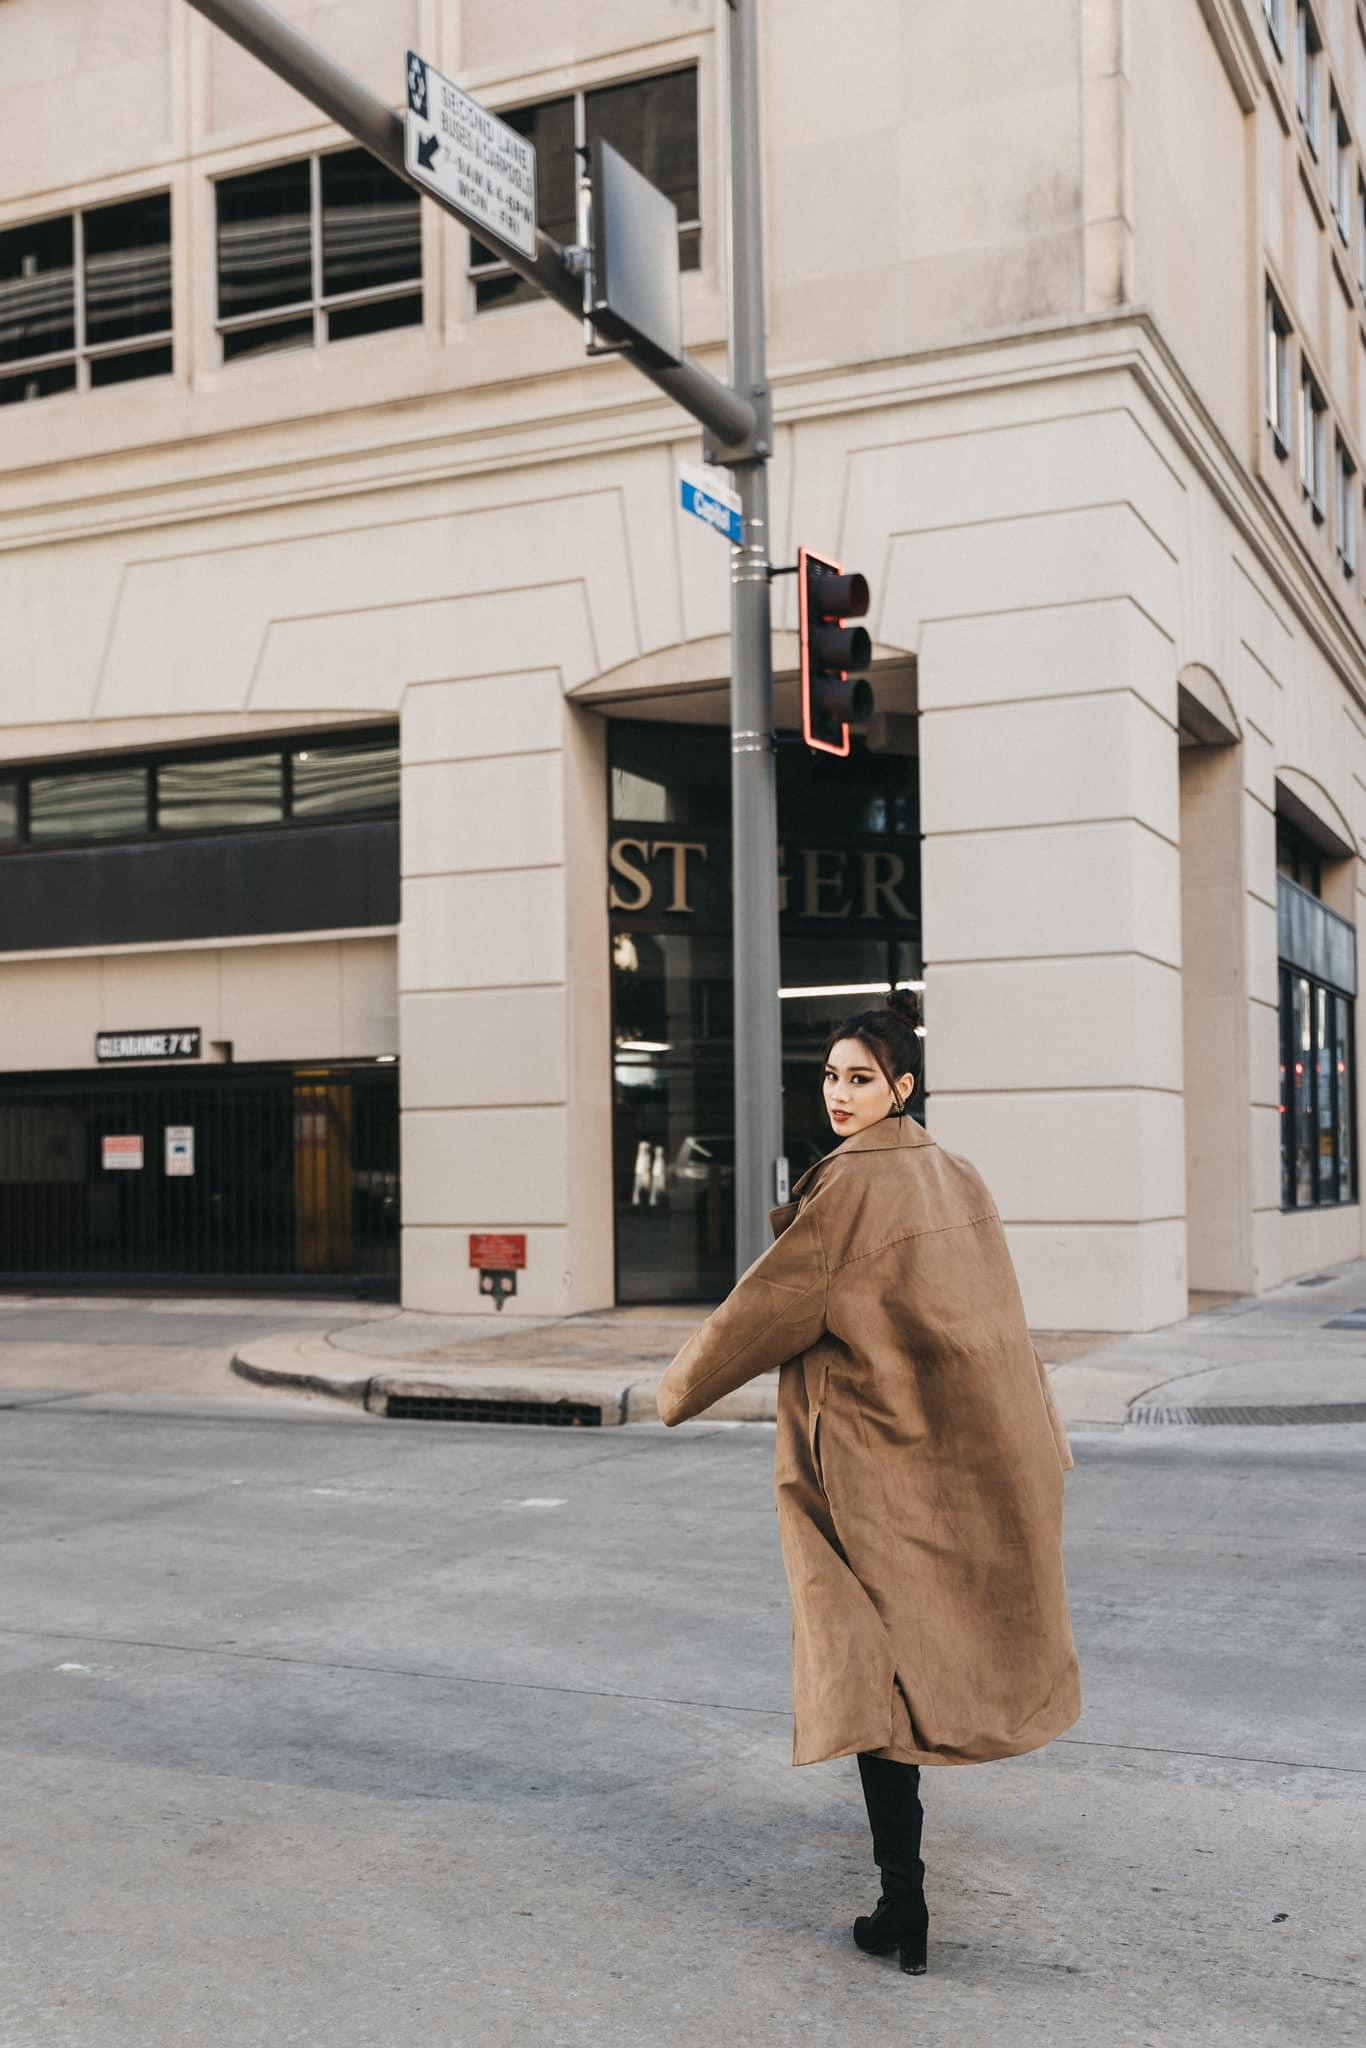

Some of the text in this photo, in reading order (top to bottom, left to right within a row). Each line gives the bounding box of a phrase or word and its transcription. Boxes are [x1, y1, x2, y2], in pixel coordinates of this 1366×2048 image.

[441, 86, 528, 170] SECOND LANE
[458, 178, 487, 213] MON
[500, 211, 520, 234] FRI
[609, 838, 918, 921] ST ER
[99, 1035, 168, 1058] CLEARANCE
